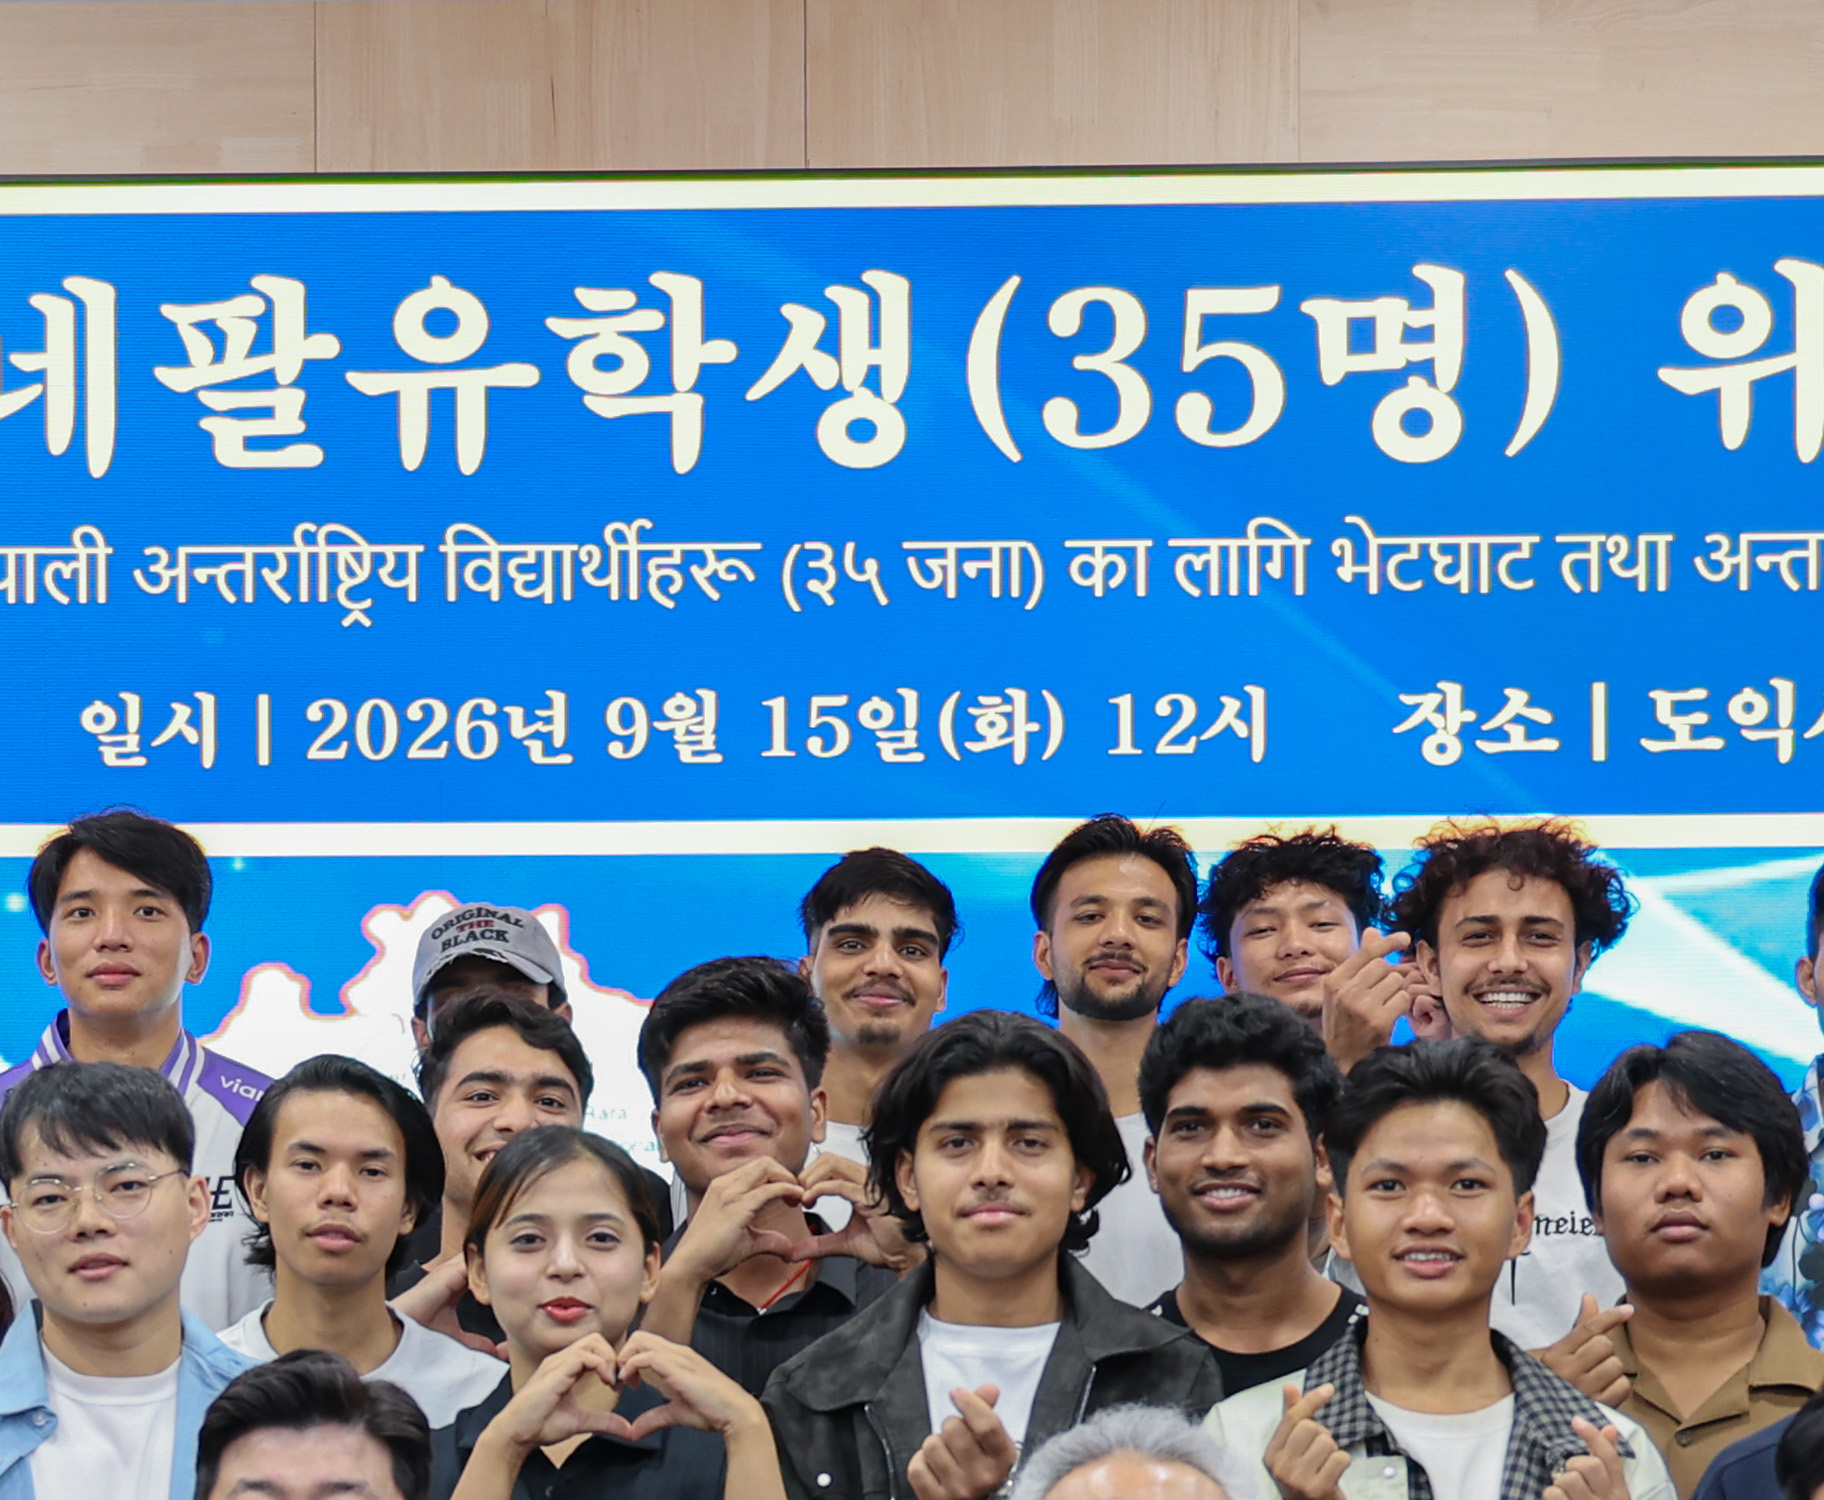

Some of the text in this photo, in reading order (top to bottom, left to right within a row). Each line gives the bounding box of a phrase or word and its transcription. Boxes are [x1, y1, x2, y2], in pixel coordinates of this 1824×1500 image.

[781, 541, 890, 612] (३५
[902, 541, 1044, 609] जना)
[1064, 539, 1153, 597] का
[1168, 517, 1311, 597] लागि
[1331, 515, 1540, 594] भेटघाट
[1555, 534, 1673, 593] तथा
[81, 692, 215, 768] 일시
[307, 690, 573, 764] 2026년
[606, 689, 723, 763] 9월
[761, 688, 1063, 765] 15일(화)
[1109, 685, 1266, 762] 12시
[1393, 681, 1559, 765] 장소
[431, 907, 524, 940] ORIGINAL
[442, 928, 509, 952] BLACK
[456, 919, 494, 932] THE
